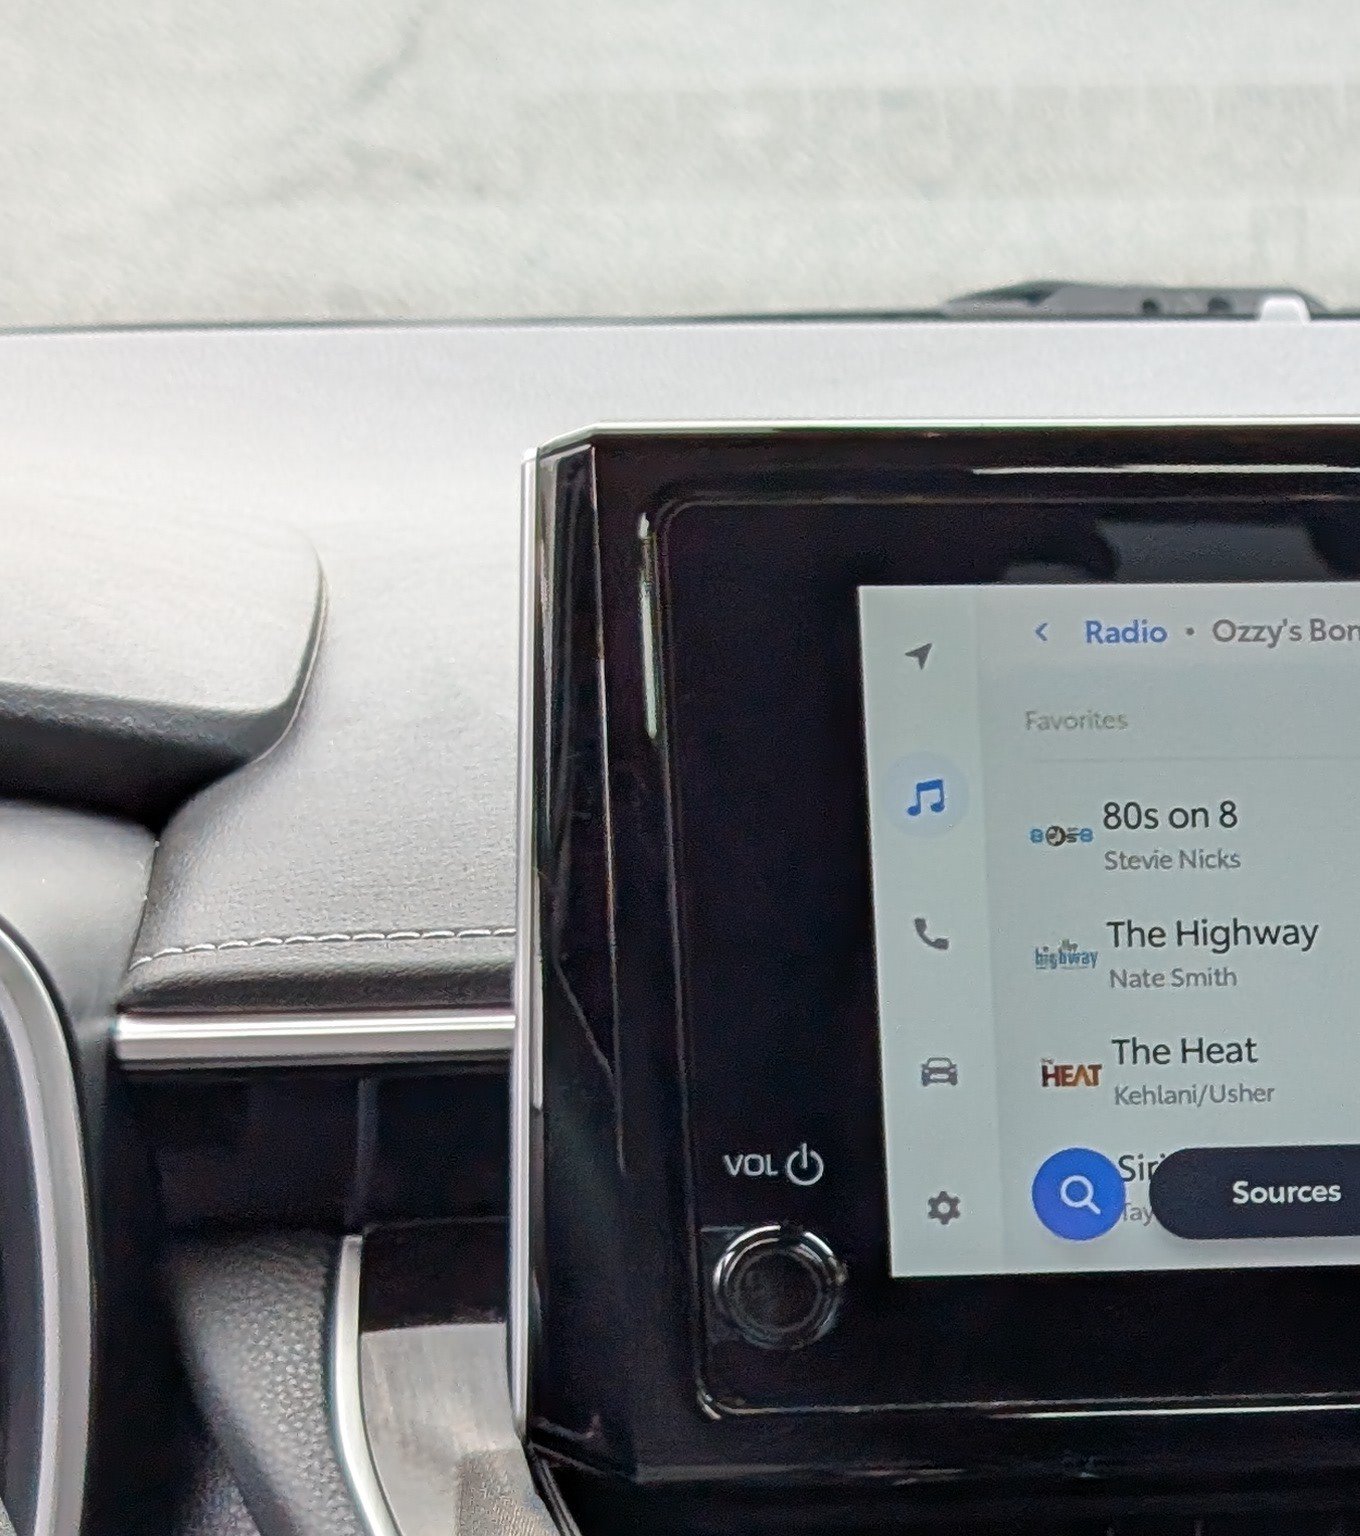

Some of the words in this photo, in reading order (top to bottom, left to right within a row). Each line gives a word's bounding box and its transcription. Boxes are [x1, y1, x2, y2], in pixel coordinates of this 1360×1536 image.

[1084, 618, 1169, 646] Radio
[1211, 617, 1303, 650] Ozzy's
[1024, 708, 1129, 733] Favorites
[1102, 800, 1160, 831] 80s
[1167, 808, 1211, 830] on
[1217, 799, 1239, 830] 8
[1103, 849, 1174, 871] Stevie
[1178, 848, 1242, 870] Nicks
[1107, 920, 1167, 950] The
[1174, 918, 1320, 955] Highway
[1108, 967, 1166, 990] Nate
[1170, 966, 1238, 989] Smith
[1111, 1038, 1171, 1066] The
[1179, 1036, 1259, 1065] Heat
[1041, 1064, 1102, 1087] HEAT
[1113, 1083, 1276, 1109] Kehlani/Usher
[722, 1153, 779, 1177] VOL
[1117, 1152, 1166, 1183] Sir
[1231, 1180, 1342, 1205] Sources
